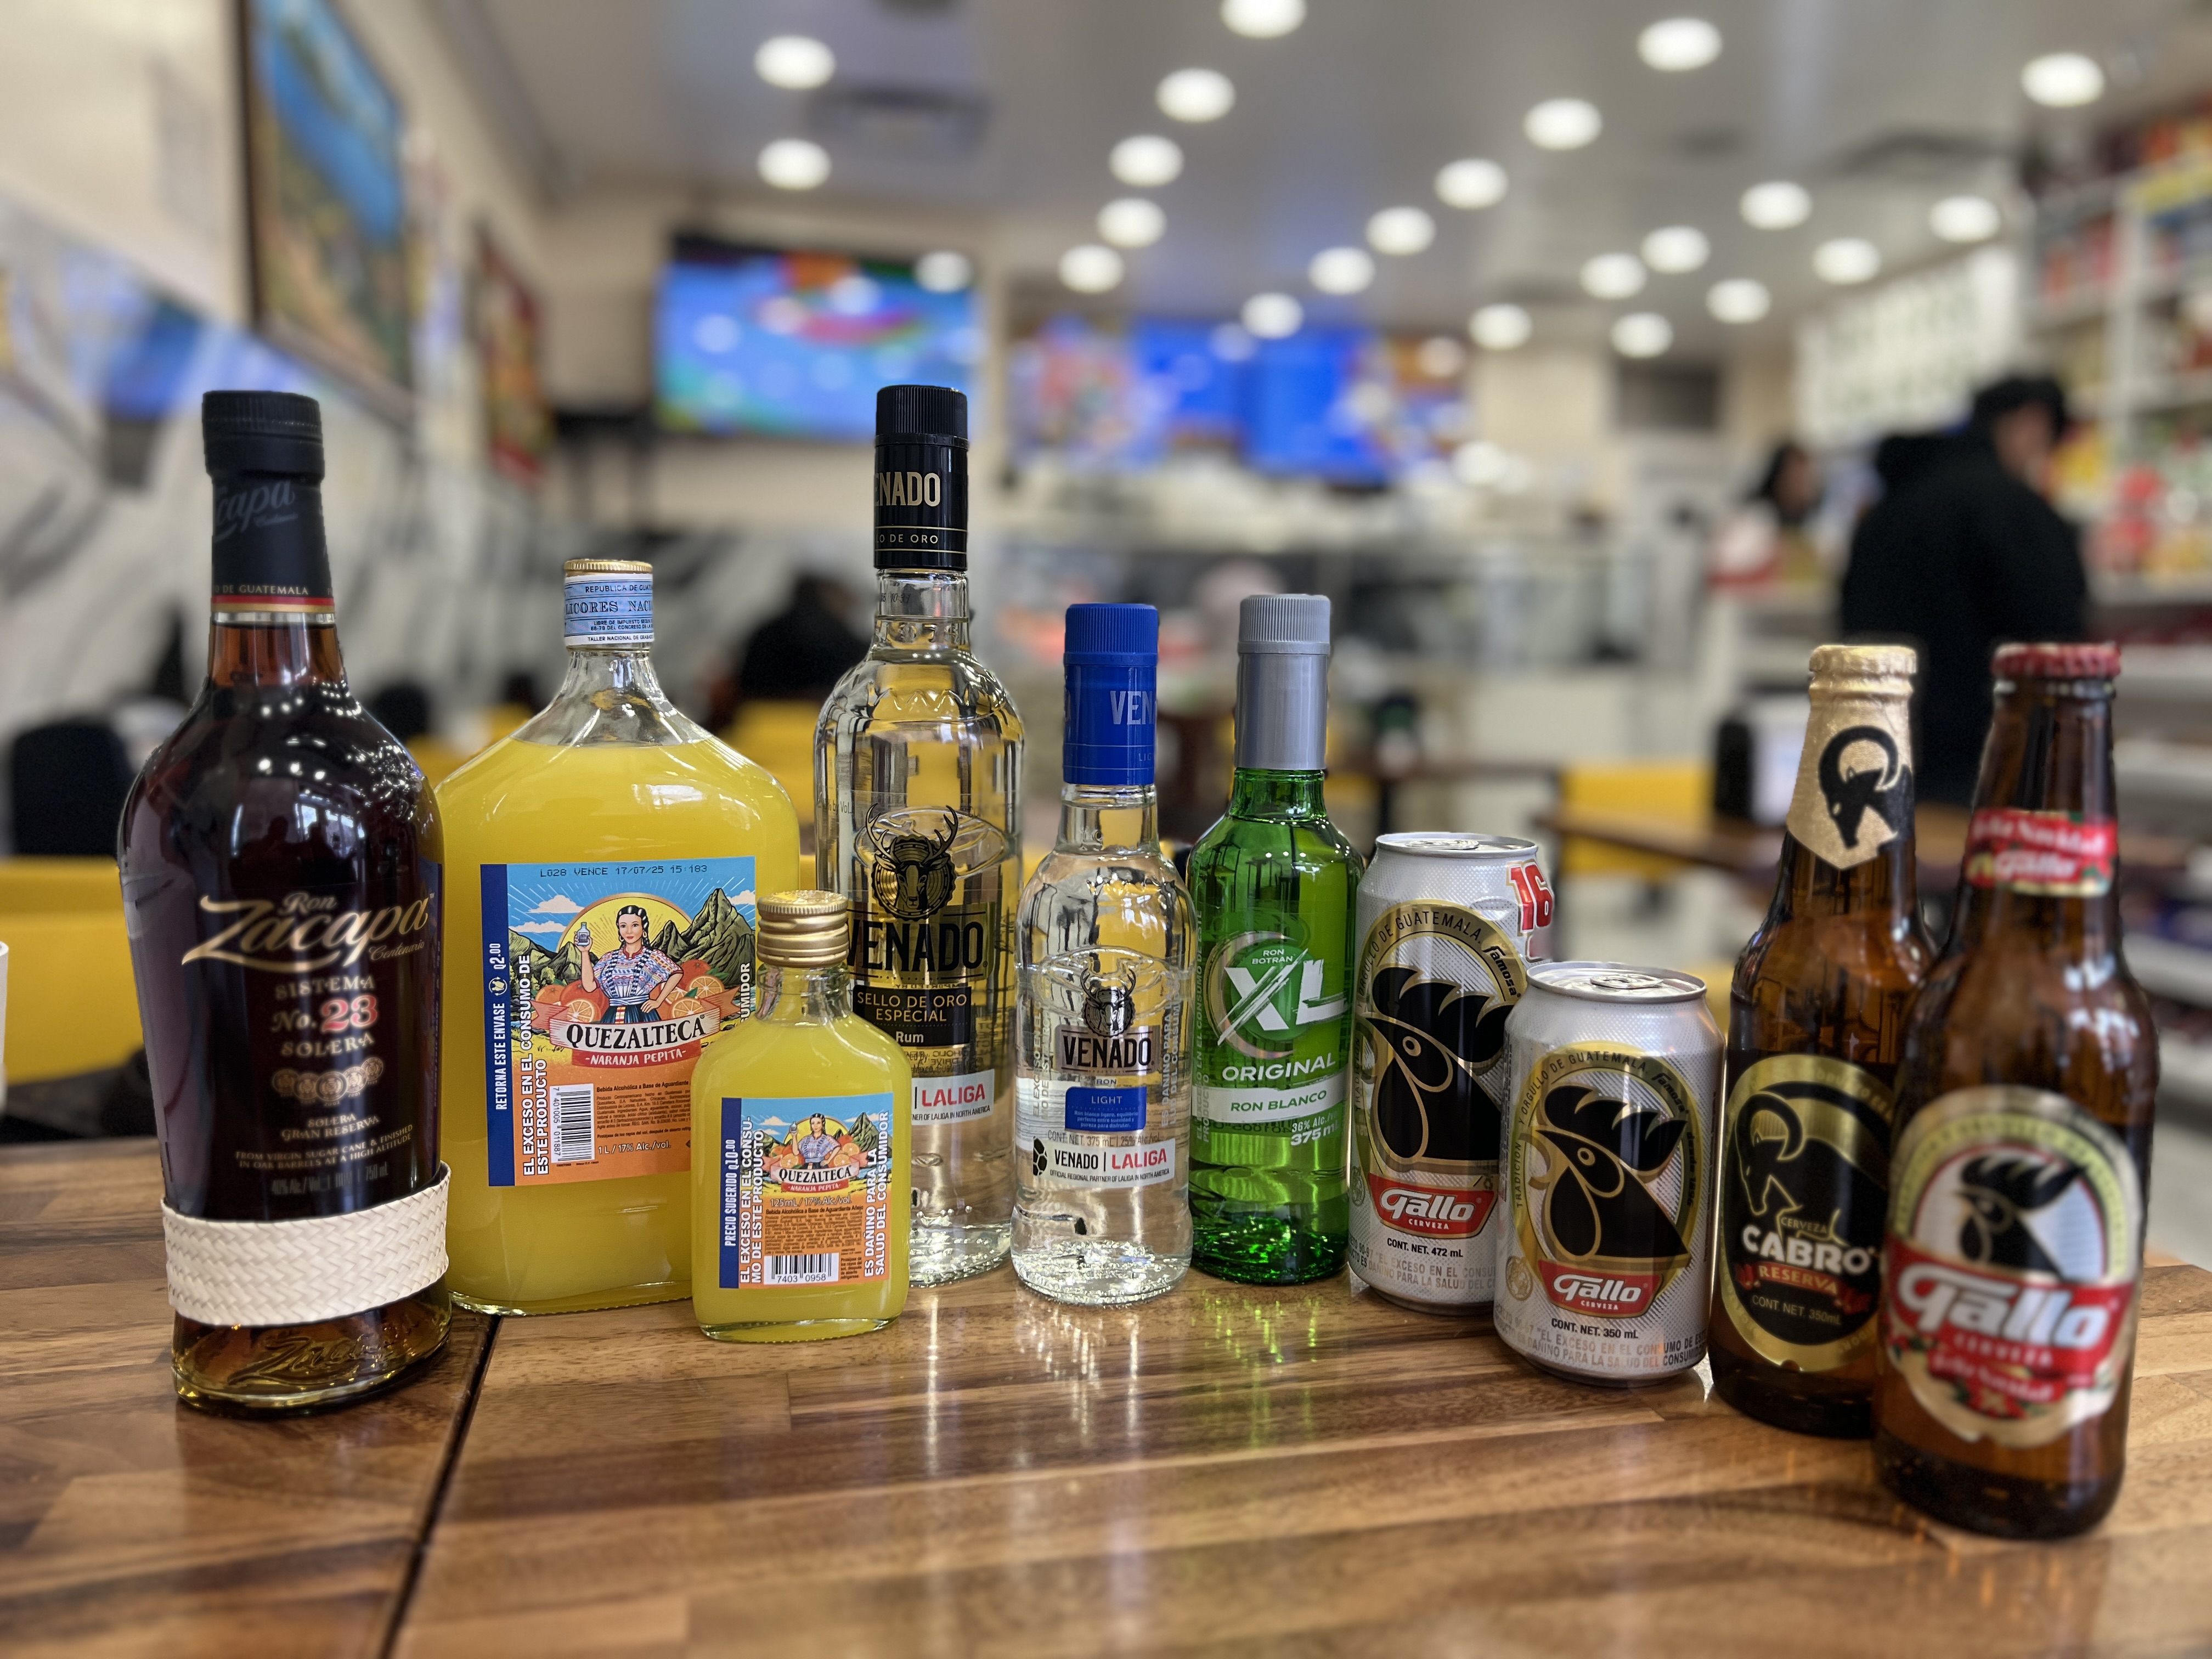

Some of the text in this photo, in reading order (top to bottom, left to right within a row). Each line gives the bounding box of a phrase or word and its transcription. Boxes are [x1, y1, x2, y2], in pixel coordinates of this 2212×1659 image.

[890, 534, 904, 543] DE
[910, 534, 938, 544] ORO
[239, 585, 308, 595] GUATEMALA
[566, 601, 619, 615] LICORES
[574, 867, 608, 876] VENCE
[616, 866, 664, 875] 17/07/25
[182, 891, 430, 973] Ron Zacapa Centenario
[848, 918, 984, 972] VENADO
[1196, 946, 1202, 962] DE
[1262, 949, 1284, 957] RON
[1379, 911, 1517, 997] DE GUATEMALA. Famosa
[1252, 956, 1293, 965] BOTRAN
[275, 975, 375, 1001] SISTEMA
[1217, 948, 1348, 1046] XL
[857, 992, 967, 1008] SELLO DE ORO
[273, 995, 378, 1033] No. 23
[876, 1008, 947, 1022] ESPECIAL
[566, 1017, 706, 1049] QUEZALTECA
[896, 1031, 924, 1043] Rum
[1197, 1034, 1202, 1048] EL
[281, 1032, 375, 1058] SOLERA
[1064, 1035, 1152, 1069] VENADO
[493, 1003, 507, 1110] RETORNA ESTE ENVASE
[518, 955, 535, 1176] EL EXCESO EN EL CONSUMO DE
[1197, 1051, 1202, 1069] EN
[1222, 1053, 1336, 1082] ORIGINAL
[921, 1082, 986, 1107] LALIGA
[1521, 1058, 1686, 1115] ORGULLO DE Famosa
[1091, 1096, 1123, 1104] LIGHT
[1231, 1090, 1327, 1111] RON BLANCO
[308, 1113, 357, 1128] SOLERA
[534, 1058, 549, 1175] ESTE PRODUCTO
[956, 1105, 990, 1118] NORTH AMERICA
[281, 1115, 380, 1141] GRAN RESERVA
[1291, 1127, 1322, 1146] 375
[1292, 1119, 1311, 1133] 36%
[236, 1152, 263, 1160] FROM
[306, 1148, 338, 1159] SUGAR
[342, 1142, 366, 1153] CANE
[381, 1124, 413, 1143] FINISHED
[325, 1133, 411, 1165] AT HIGH ALTITUDE
[618, 1143, 634, 1152] 17%
[1087, 1136, 1100, 1147] 375
[1054, 1148, 1167, 1170] VENADO LALIGA
[779, 1166, 851, 1183] QUEZALTECA
[1049, 1169, 1066, 1178] OFFICIAL
[1154, 1168, 1170, 1178] AMERICA
[1515, 1141, 1523, 1208] TRADICION
[724, 1172, 737, 1214] SUGERIDO
[740, 1116, 753, 1283] EL EXCESO EN EL CONSU-
[804, 1197, 821, 1205] 17%
[875, 1111, 889, 1276] SALUD DEL CONSUMIDOR
[751, 1130, 764, 1283] MO DE ESTE PRODUCTO
[863, 1147, 877, 1277] ES DAÑINO PARA LA
[1380, 1187, 1476, 1221] Gallo
[724, 1216, 737, 1247] PRECIO
[1408, 1218, 1449, 1230] CERVEZA
[1781, 1217, 1828, 1234] CERVEZA
[1387, 1237, 1464, 1257] CONT. NET. 472 mL
[1742, 1224, 1870, 1275] CABRO
[1391, 1256, 1458, 1278] EXCESO EN EL
[805, 1274, 826, 1282] 0958
[1397, 1271, 1466, 1290] PARA LA SALUD
[1553, 1273, 1642, 1302] Gallo
[1759, 1266, 1837, 1294] RESERVA
[1580, 1300, 1619, 1311] CERVEZA
[1898, 1264, 2110, 1350] Gallo
[1551, 1318, 1639, 1339] CONT. NET. 350 mL
[1556, 1334, 1693, 1355] EXCESO EN EL DE
[1564, 1348, 1605, 1367] PARA LA
